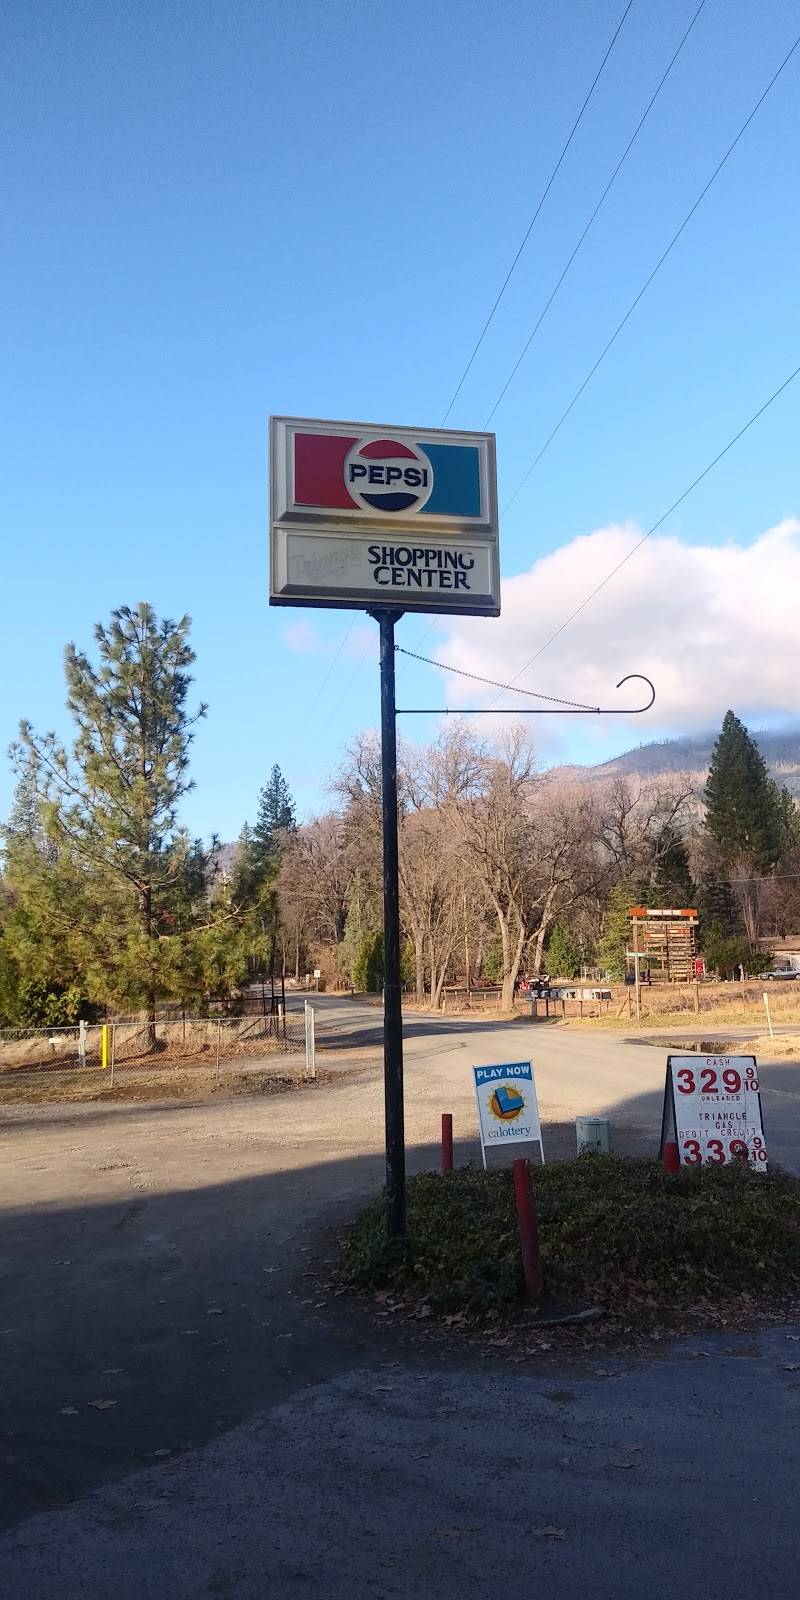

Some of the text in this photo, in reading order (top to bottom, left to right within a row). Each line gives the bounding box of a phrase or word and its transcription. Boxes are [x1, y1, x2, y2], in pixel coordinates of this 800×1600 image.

[349, 463, 428, 488] PEPSI
[367, 545, 475, 570] SHOPPING
[373, 566, 471, 590] CENTER
[477, 1066, 529, 1079] PLAY NOW
[677, 1068, 742, 1094] 329
[698, 1112, 748, 1121] TRIANGLE
[488, 1126, 531, 1138] calottery
[715, 1121, 733, 1130] GAS
[679, 1128, 757, 1139] DEBIT CREDIT
